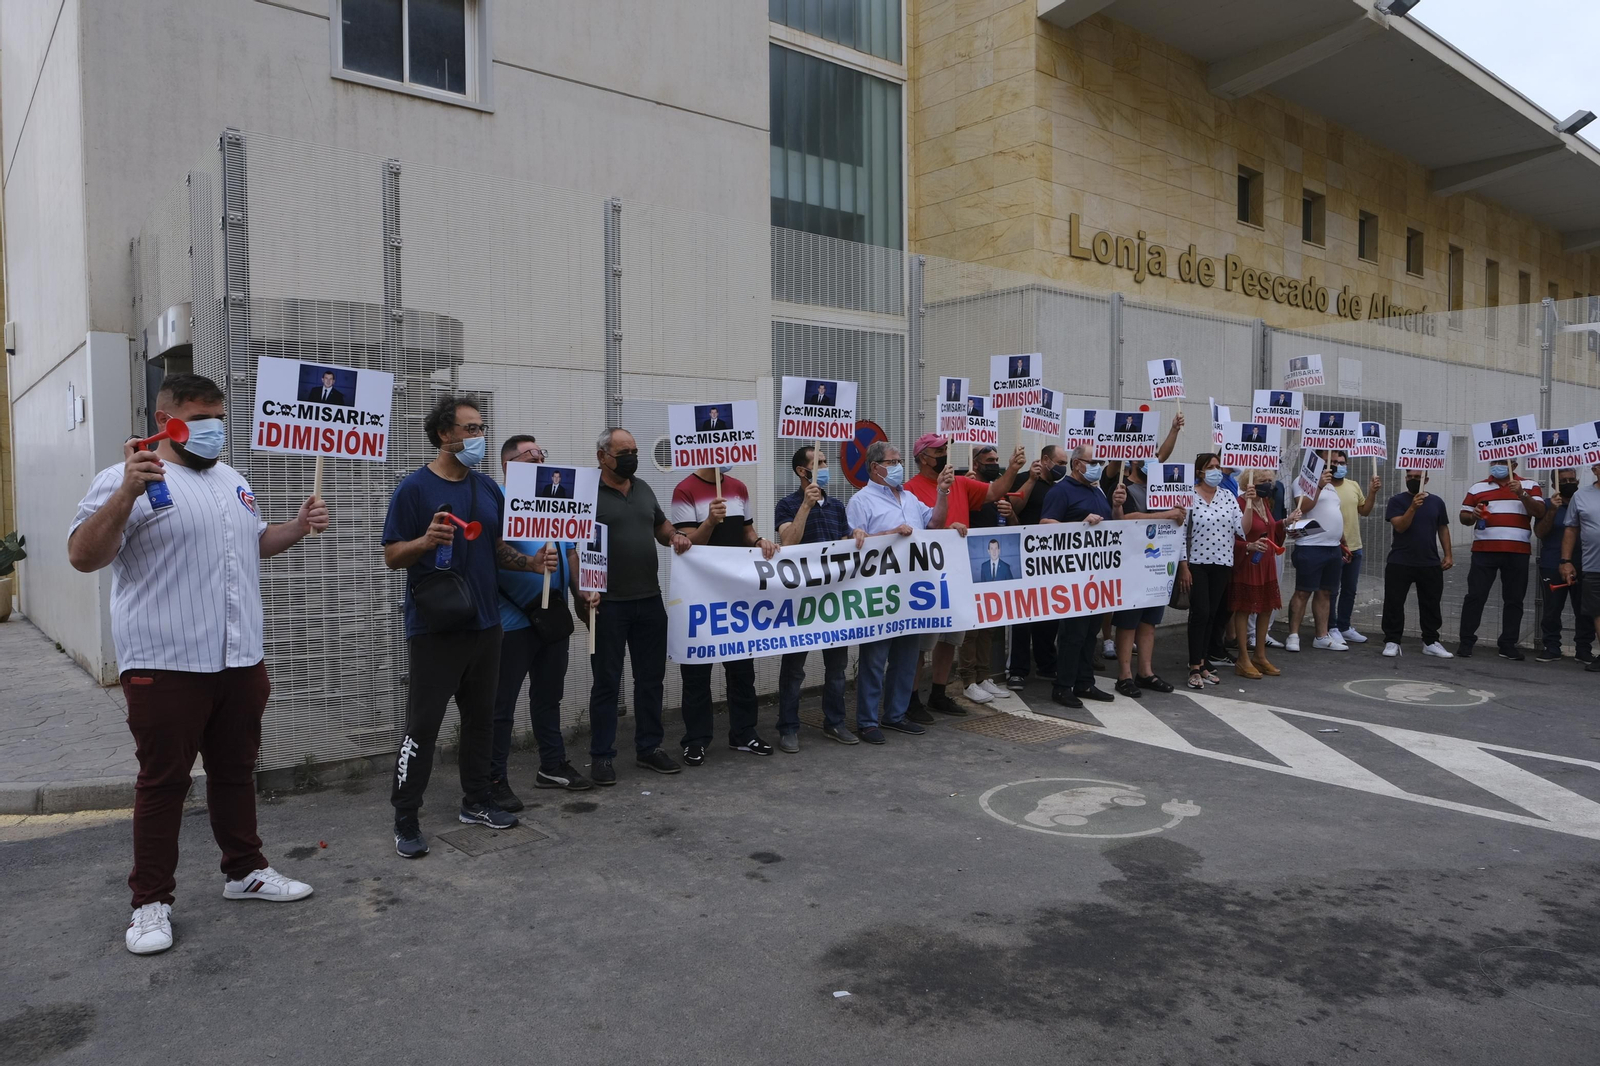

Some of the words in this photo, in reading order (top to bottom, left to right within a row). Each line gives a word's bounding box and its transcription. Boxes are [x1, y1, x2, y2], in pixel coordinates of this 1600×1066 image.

[1070, 212, 1167, 283] Lonja
[1179, 244, 1215, 287] de
[1225, 253, 1330, 313] Pescado
[1337, 285, 1362, 321] de
[992, 388, 1041, 408] ¡DIMISIÓN!
[781, 419, 853, 439] ¡DIMISIÓN!
[1022, 415, 1060, 436] ¡DIMISIÓN!
[257, 421, 385, 457] ¡DIMISIÓN!
[1303, 436, 1356, 448] ¡DIMISIÓN!
[674, 443, 757, 467] ¡DIMISIÓN!
[1095, 444, 1156, 458] ¡DIMISIÓN!
[1224, 452, 1278, 468] ¡DIMISIÓN!
[1479, 442, 1538, 460] ¡DIMISIÓN!
[1399, 456, 1444, 469] ¡DIMISIÓN!
[1149, 494, 1194, 508] ¡DIMISIÓN!
[508, 516, 592, 539] ¡DIMISIÓN!
[754, 547, 900, 590] POLÍTICA
[909, 542, 944, 572] NO
[1025, 550, 1121, 577] SINKEVICIUS
[688, 584, 900, 638] PESCADORES
[908, 573, 950, 612] SÍ
[975, 575, 1122, 624] ¡DIMISIÓN!
[687, 646, 716, 658] POR
[719, 641, 745, 656] UNA
[748, 637, 788, 652] PESCA
[790, 626, 876, 646] RESPONSABLE
[877, 624, 884, 636] Y
[886, 616, 952, 633] SOSTENIBLE
